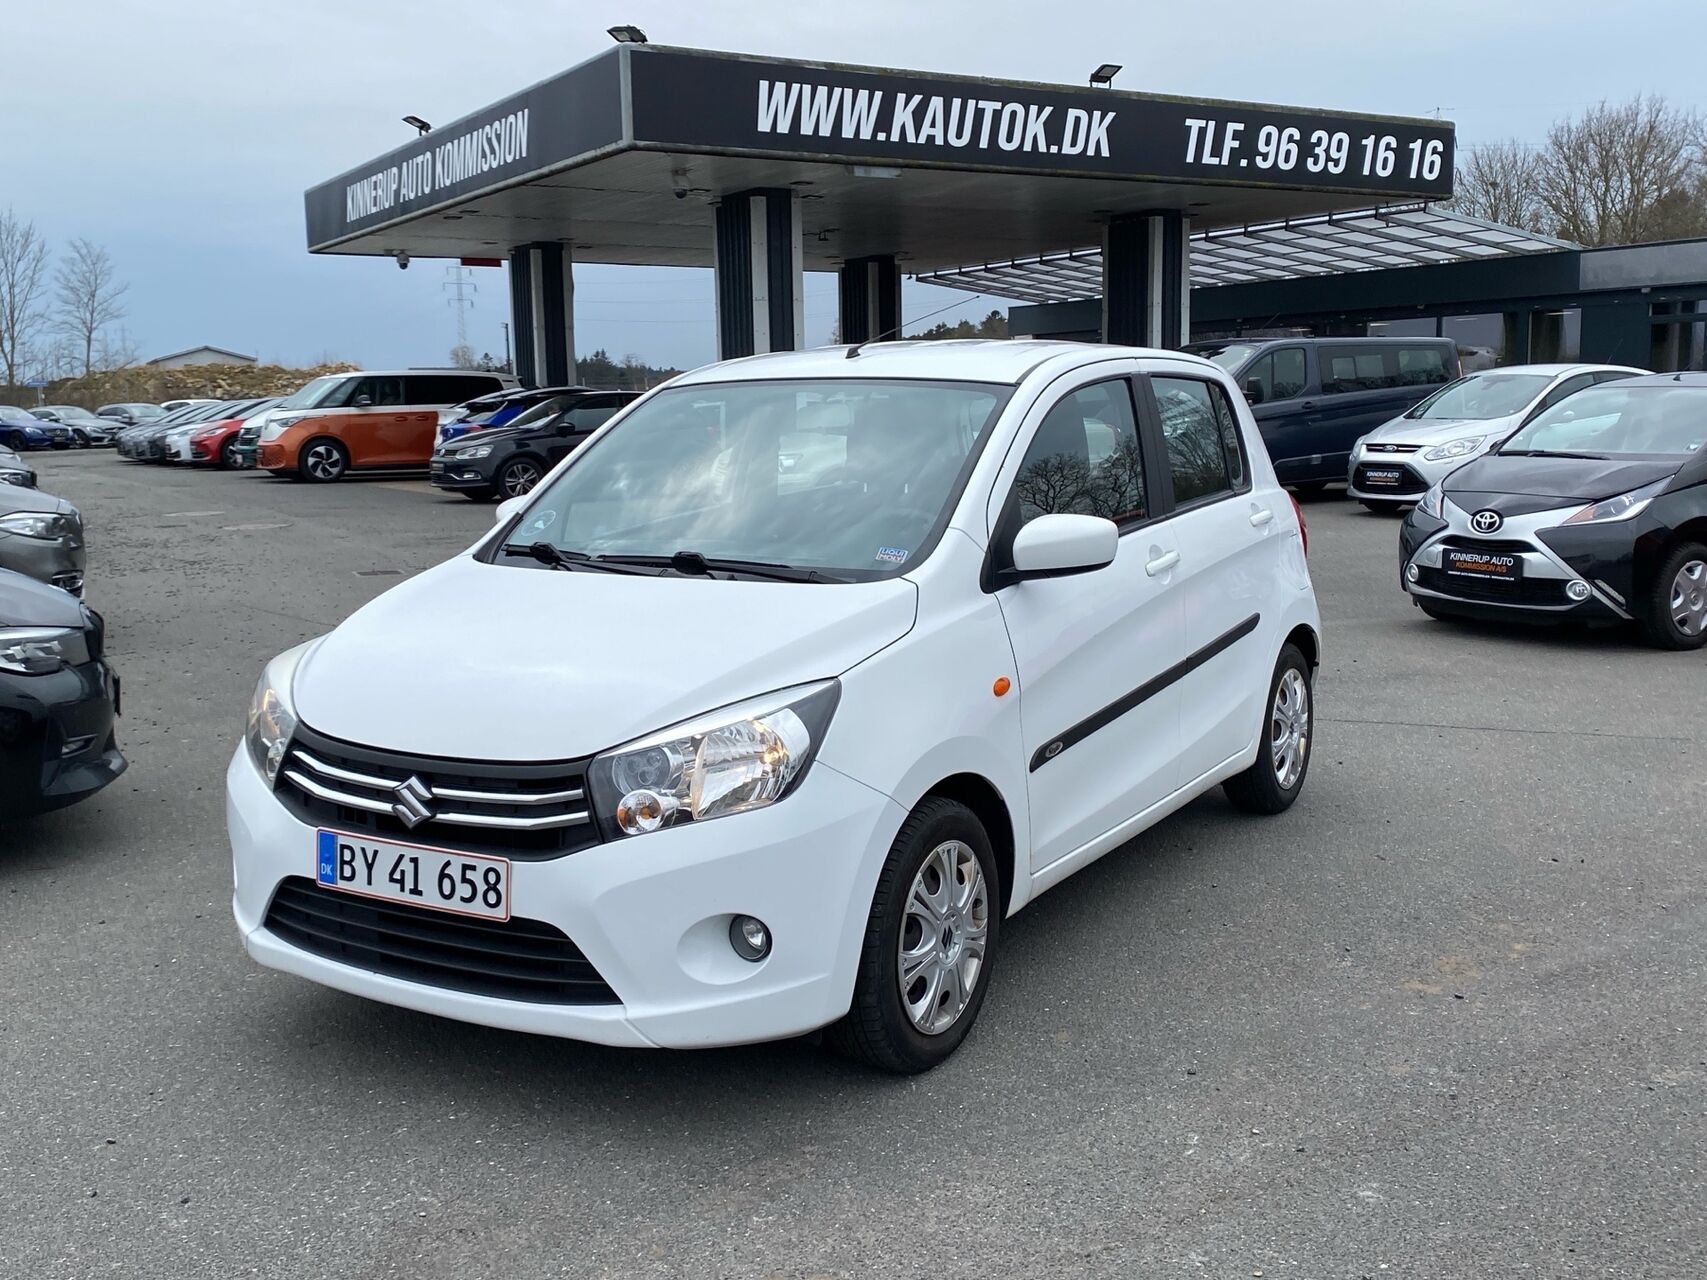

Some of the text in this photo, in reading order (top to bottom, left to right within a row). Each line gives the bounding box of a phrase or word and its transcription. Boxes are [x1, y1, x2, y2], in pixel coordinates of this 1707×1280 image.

[757, 80, 1116, 157] WWW.KAUTOK.DK
[1185, 118, 1444, 181] TLF. 96 39 16 16
[346, 108, 529, 223] KINNERUP AUTO KOMMISSION
[1450, 552, 1514, 566] KINNERUP AUTO
[1456, 561, 1496, 571] KOMMISSION
[320, 862, 333, 876] DK
[339, 843, 502, 909] BY 41 658
